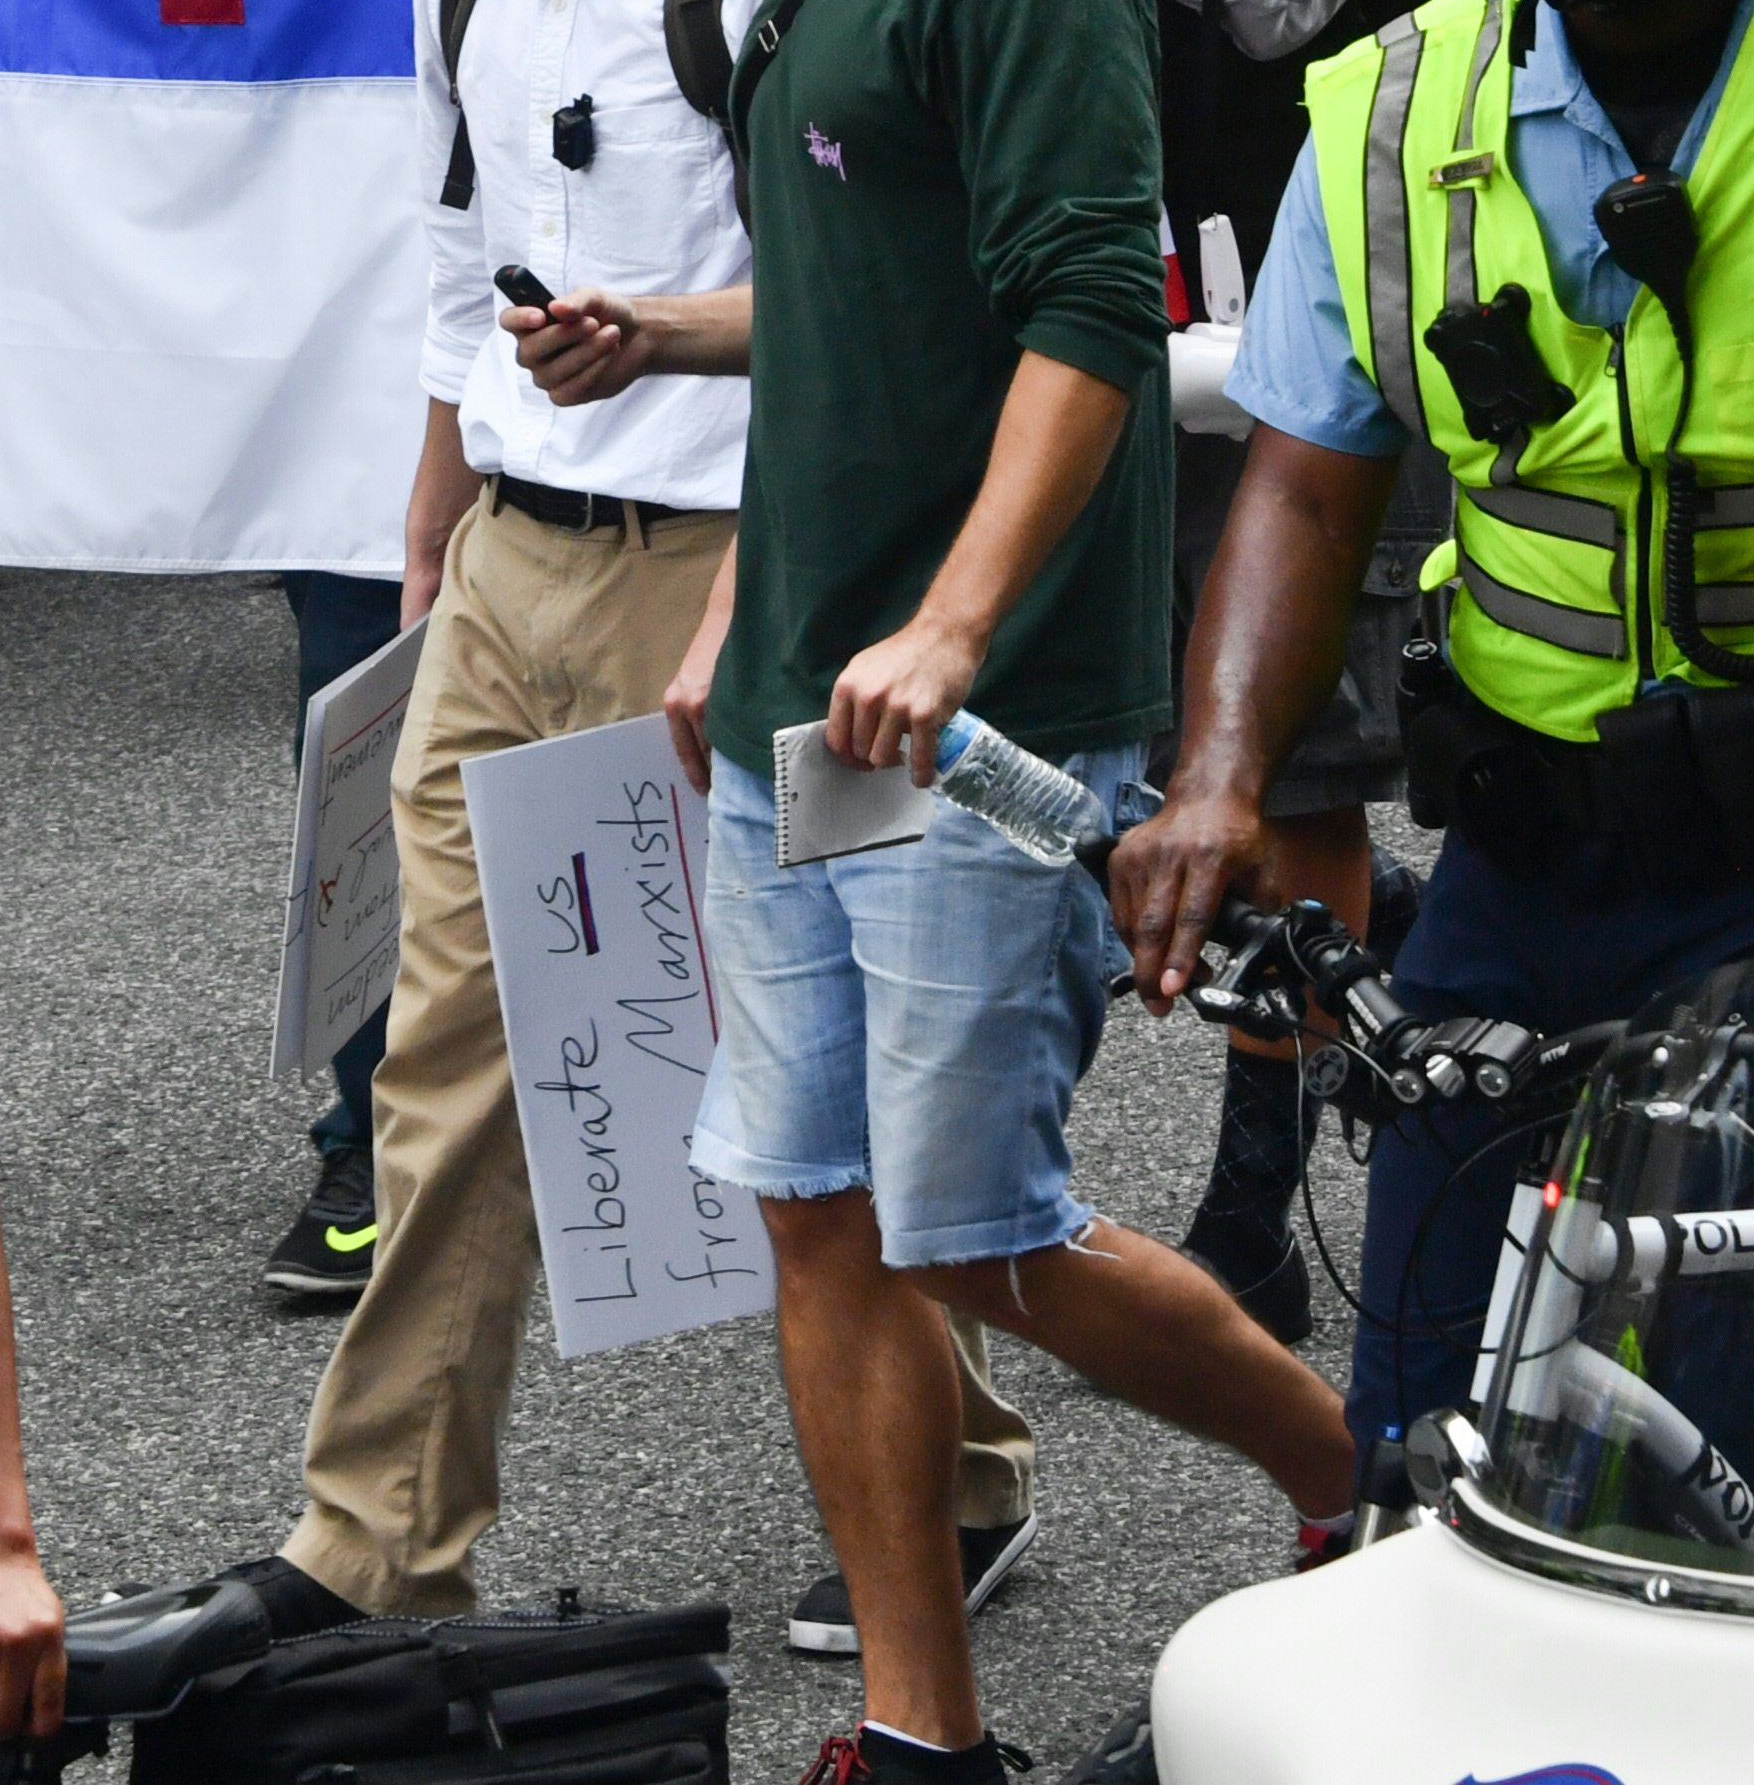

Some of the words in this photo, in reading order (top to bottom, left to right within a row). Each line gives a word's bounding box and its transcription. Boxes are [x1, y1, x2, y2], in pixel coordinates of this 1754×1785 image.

[327, 936, 400, 1025] eedom
[537, 874, 580, 955] us
[596, 779, 706, 1076] Marxists
[534, 1018, 638, 1303] Liberate
